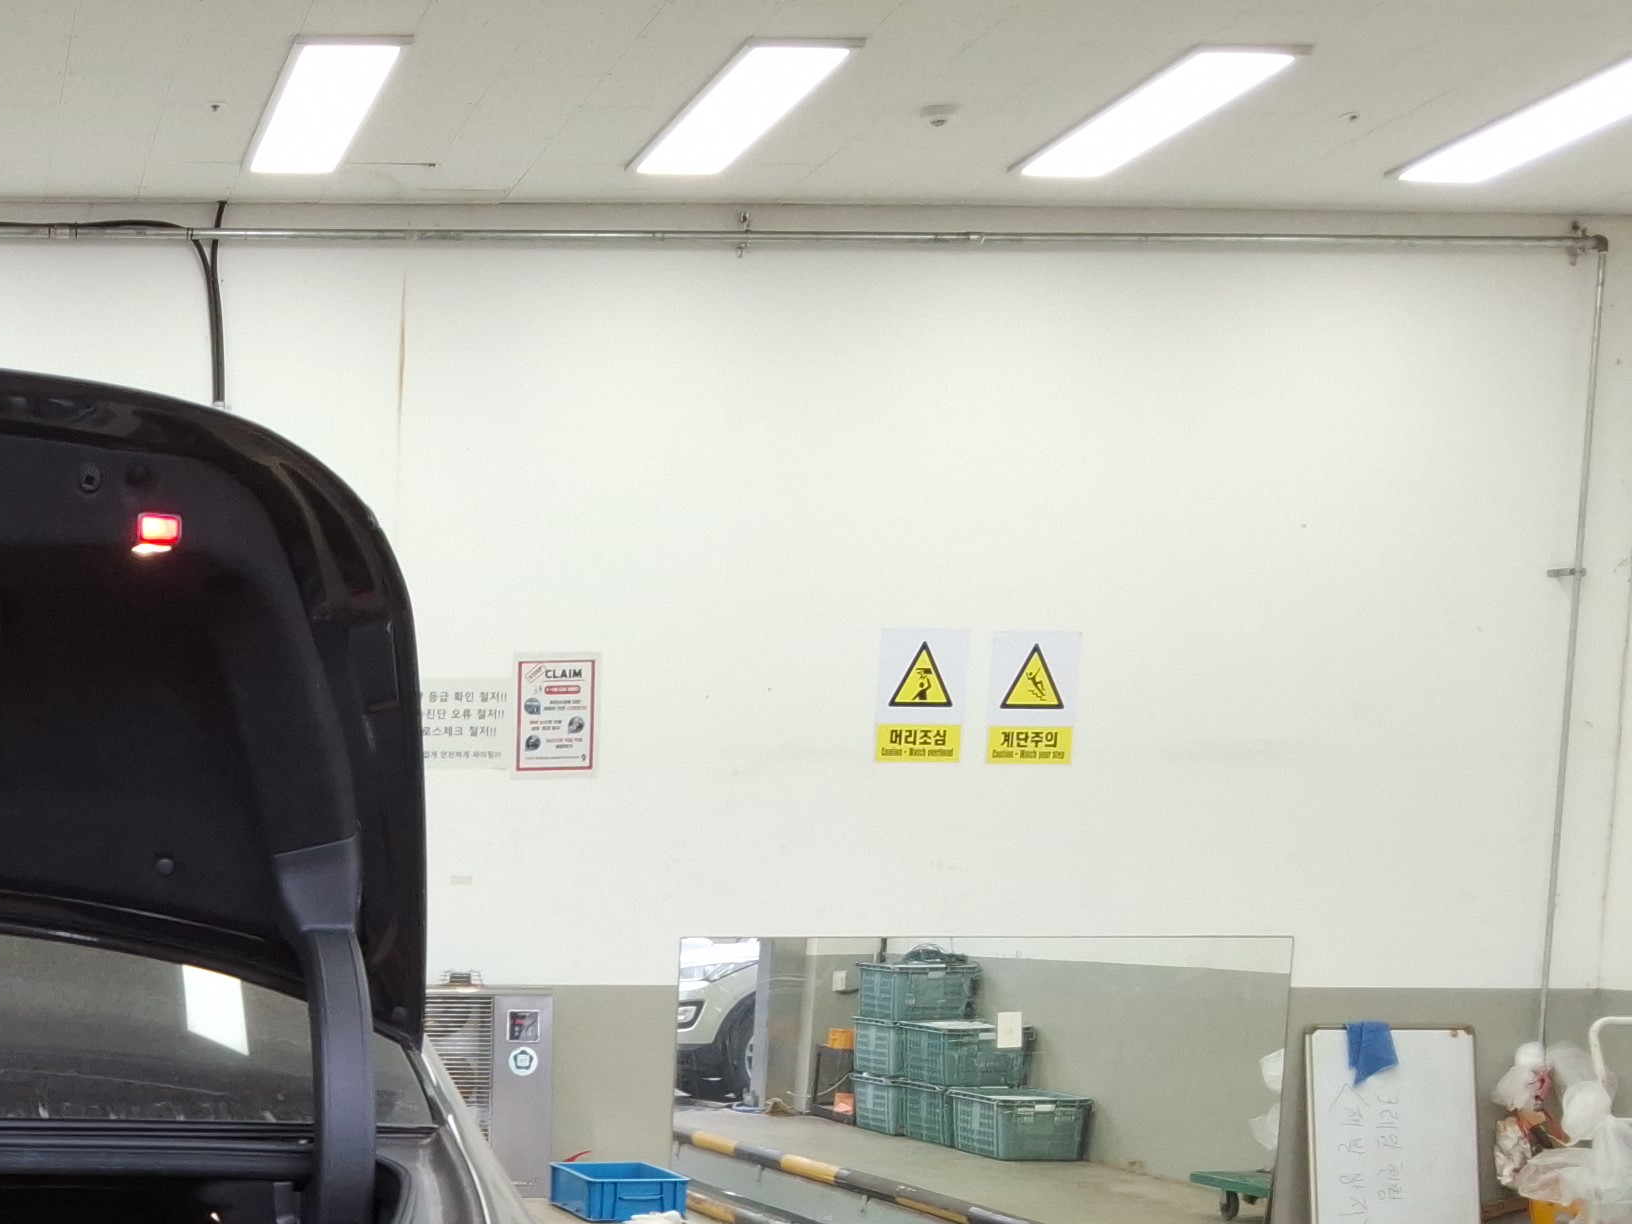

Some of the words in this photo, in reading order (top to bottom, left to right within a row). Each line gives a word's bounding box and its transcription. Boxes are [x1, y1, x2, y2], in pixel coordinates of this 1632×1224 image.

[545, 669, 583, 679] CLAIM
[454, 691, 474, 702] 확인
[480, 691, 507, 702] 철저!!
[451, 708, 472, 720] 오류
[477, 708, 504, 720] 철저!!
[469, 726, 496, 737] 철저!!
[890, 729, 947, 746] 머리조심
[1000, 731, 1058, 748] 계단주의
